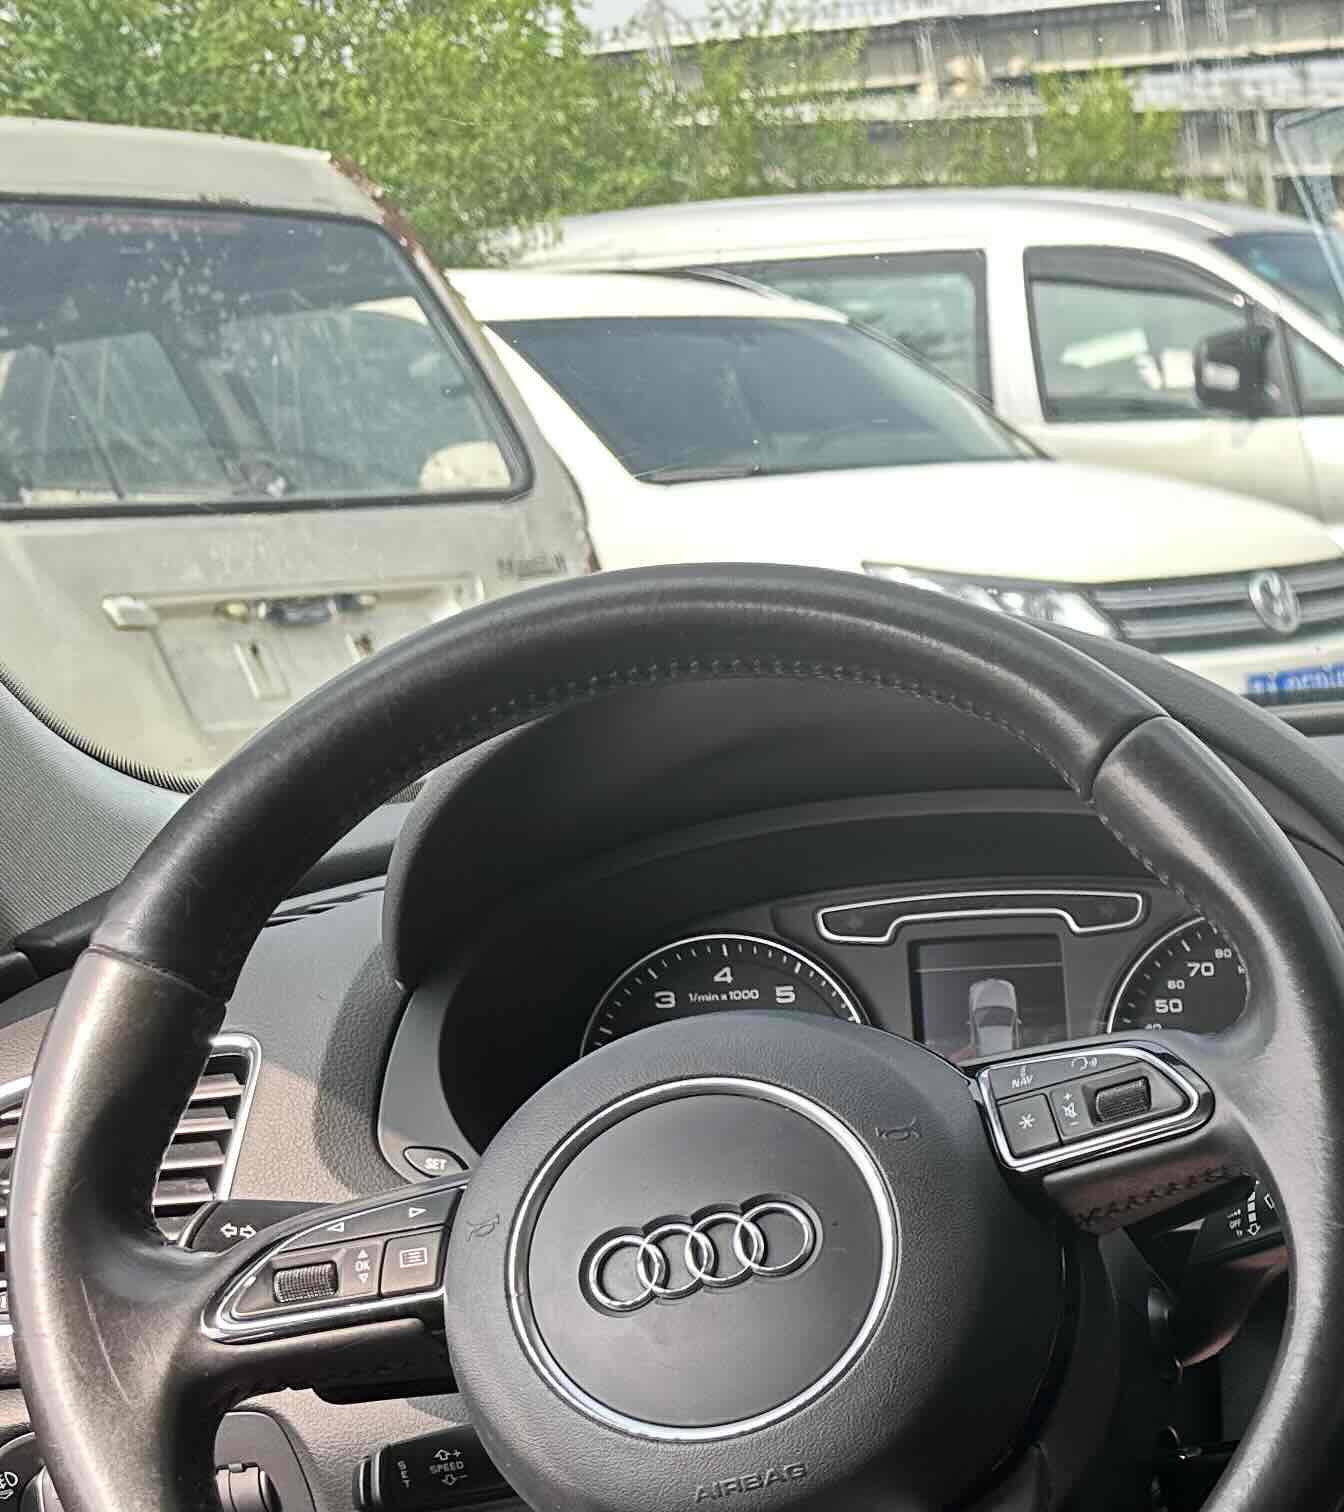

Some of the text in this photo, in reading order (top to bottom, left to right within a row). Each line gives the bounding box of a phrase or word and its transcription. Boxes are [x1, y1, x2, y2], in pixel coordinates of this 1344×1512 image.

[713, 966, 734, 984] 4
[1187, 961, 1215, 977] 70
[655, 991, 676, 1008] 3
[776, 985, 796, 1004] 5
[1154, 998, 1183, 1014] 50
[1011, 1074, 1034, 1089] NAV
[354, 1260, 371, 1273] OK
[429, 1461, 465, 1474] SPEED
[694, 1462, 808, 1503] AIRBAG
